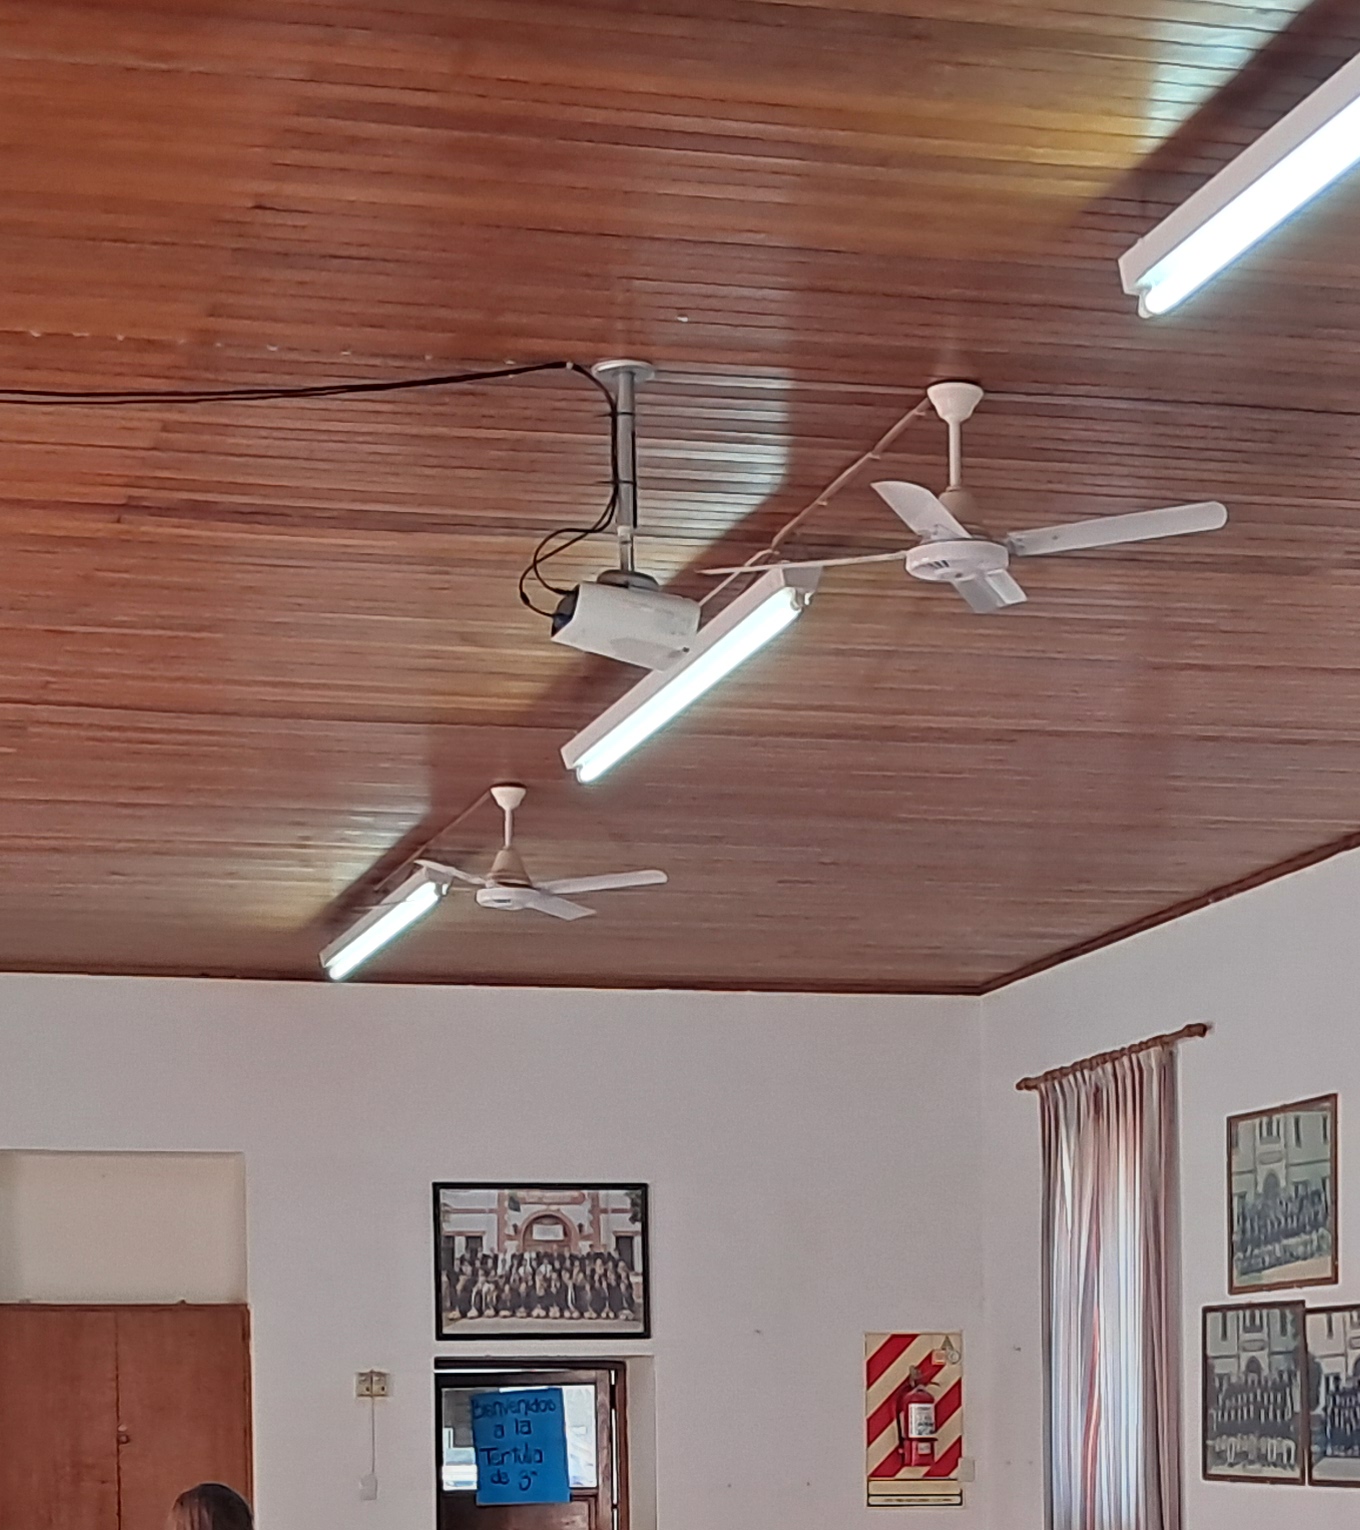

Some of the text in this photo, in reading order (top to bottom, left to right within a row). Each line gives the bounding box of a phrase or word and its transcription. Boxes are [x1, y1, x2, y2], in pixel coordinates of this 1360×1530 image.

[493, 1418, 533, 1440] a la
[479, 1442, 544, 1466] Tertulia
[489, 1468, 511, 1486] de
